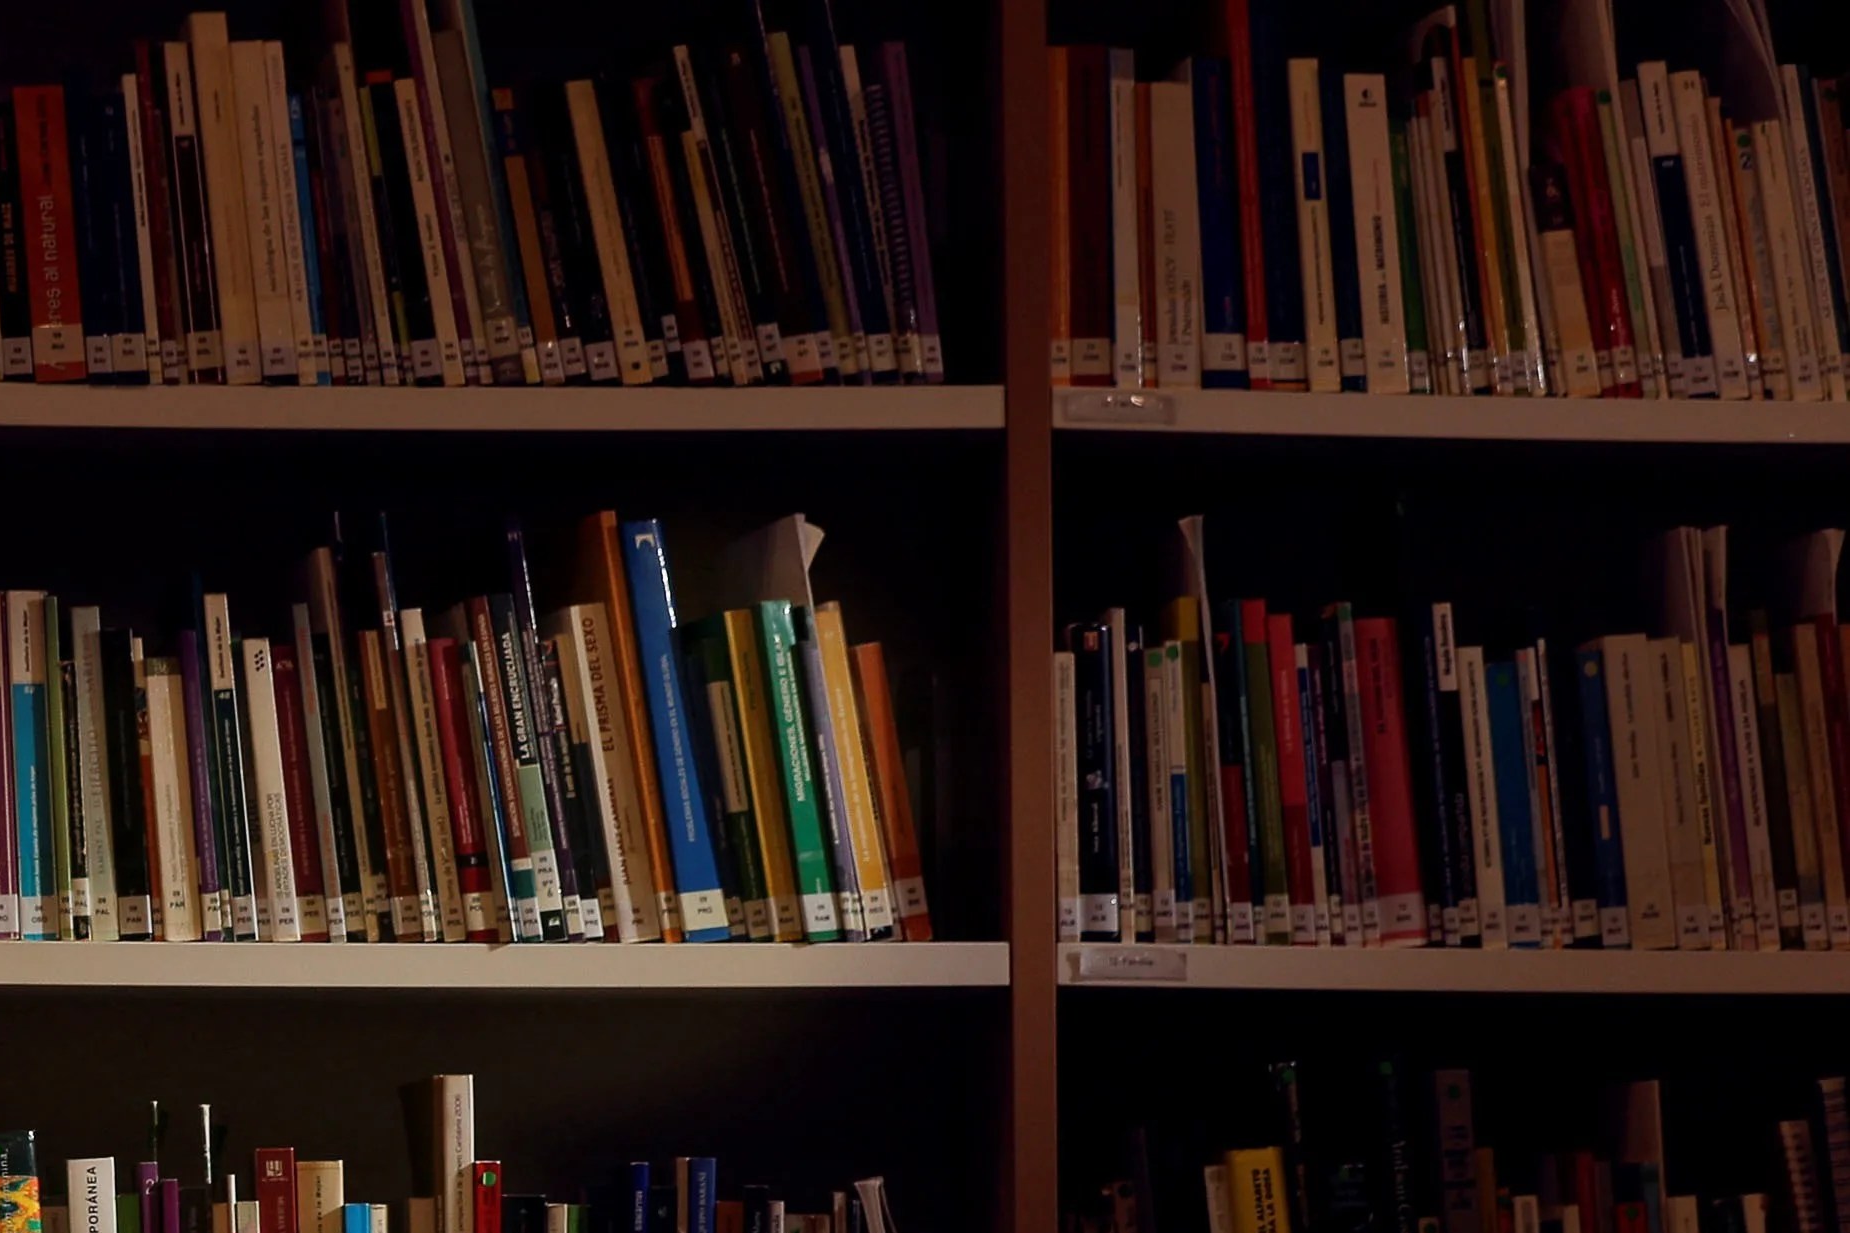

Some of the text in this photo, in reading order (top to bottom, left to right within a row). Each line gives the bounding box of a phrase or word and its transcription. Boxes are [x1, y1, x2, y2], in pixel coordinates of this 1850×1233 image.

[36, 192, 58, 261] natural
[40, 265, 60, 281] al
[500, 632, 531, 759] LA GRAN ENCRUCIJADA
[582, 617, 615, 752] EL PRISMA DEL SEXO
